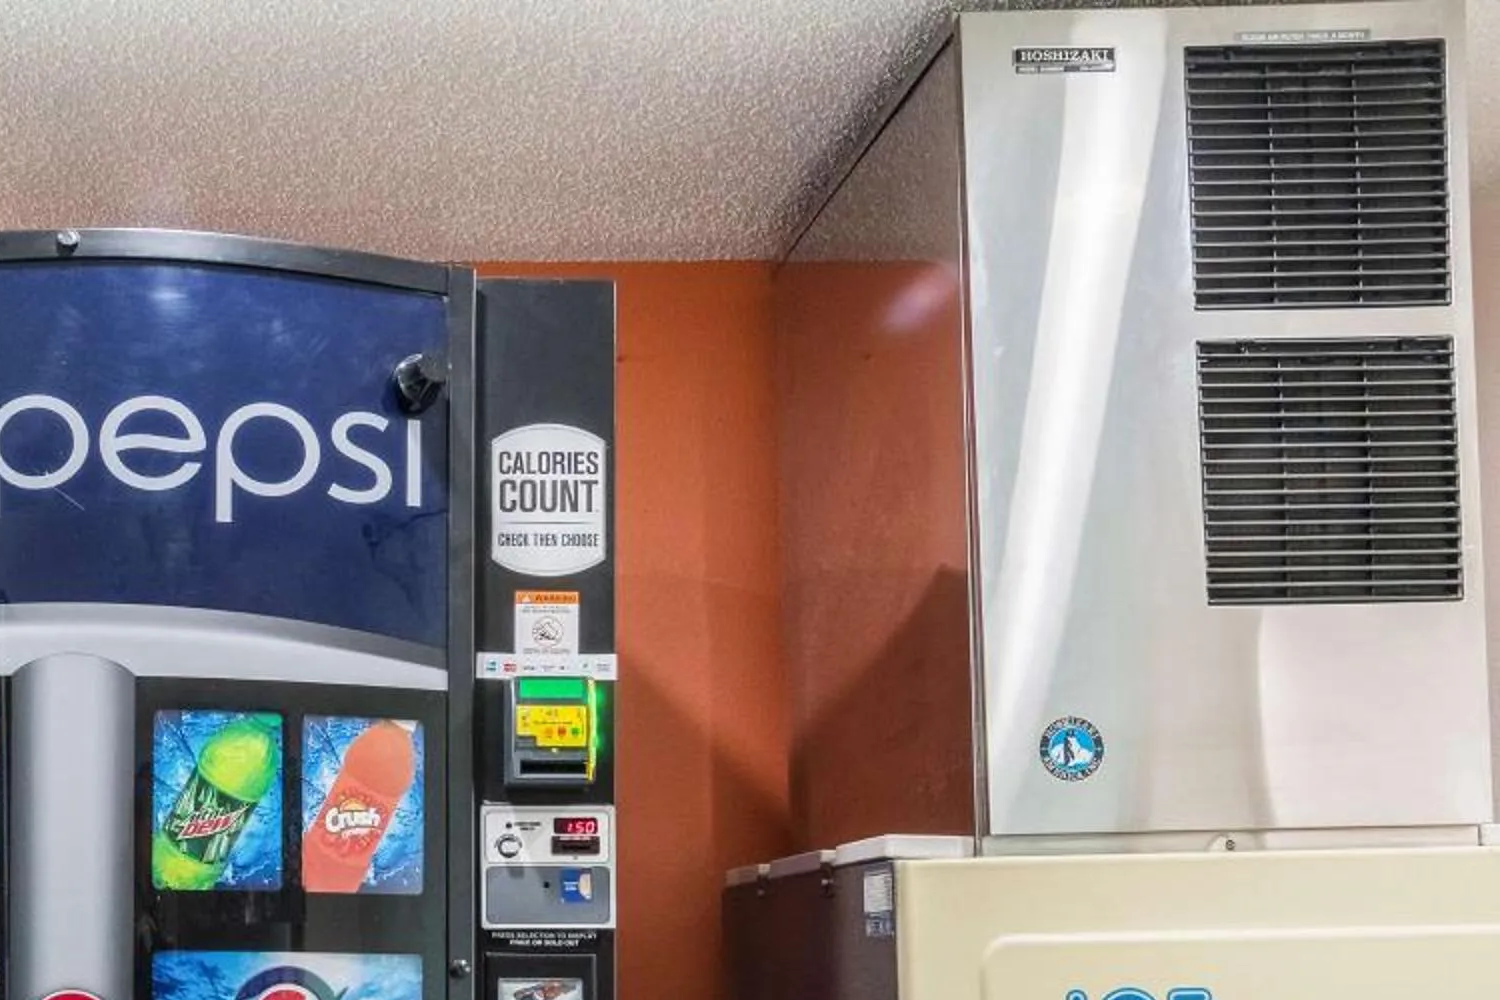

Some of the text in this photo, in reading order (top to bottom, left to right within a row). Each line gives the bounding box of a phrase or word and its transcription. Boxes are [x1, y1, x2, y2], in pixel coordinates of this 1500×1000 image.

[1020, 49, 1109, 62] HOSHIZAKI
[499, 451, 600, 476] CALORIES
[499, 479, 600, 513] COUNT
[497, 532, 600, 548] CHECK THEN CHOOSE
[325, 806, 381, 833] Crush
